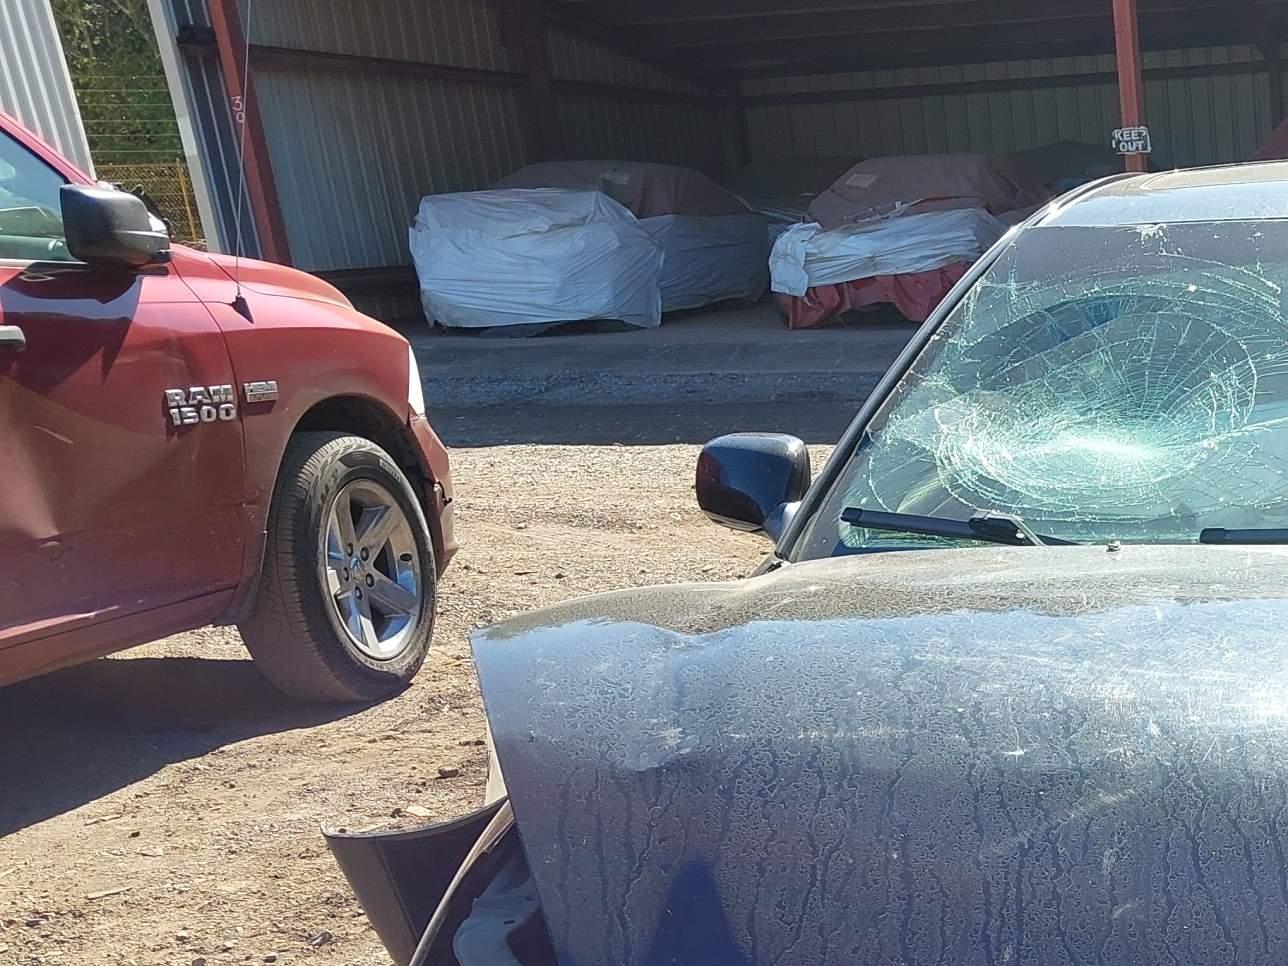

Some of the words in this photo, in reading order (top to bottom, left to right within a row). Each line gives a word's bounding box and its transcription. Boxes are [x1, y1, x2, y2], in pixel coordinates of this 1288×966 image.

[1119, 140, 1145, 152] OUT
[164, 384, 234, 407] RAM
[169, 403, 236, 426] 1500
